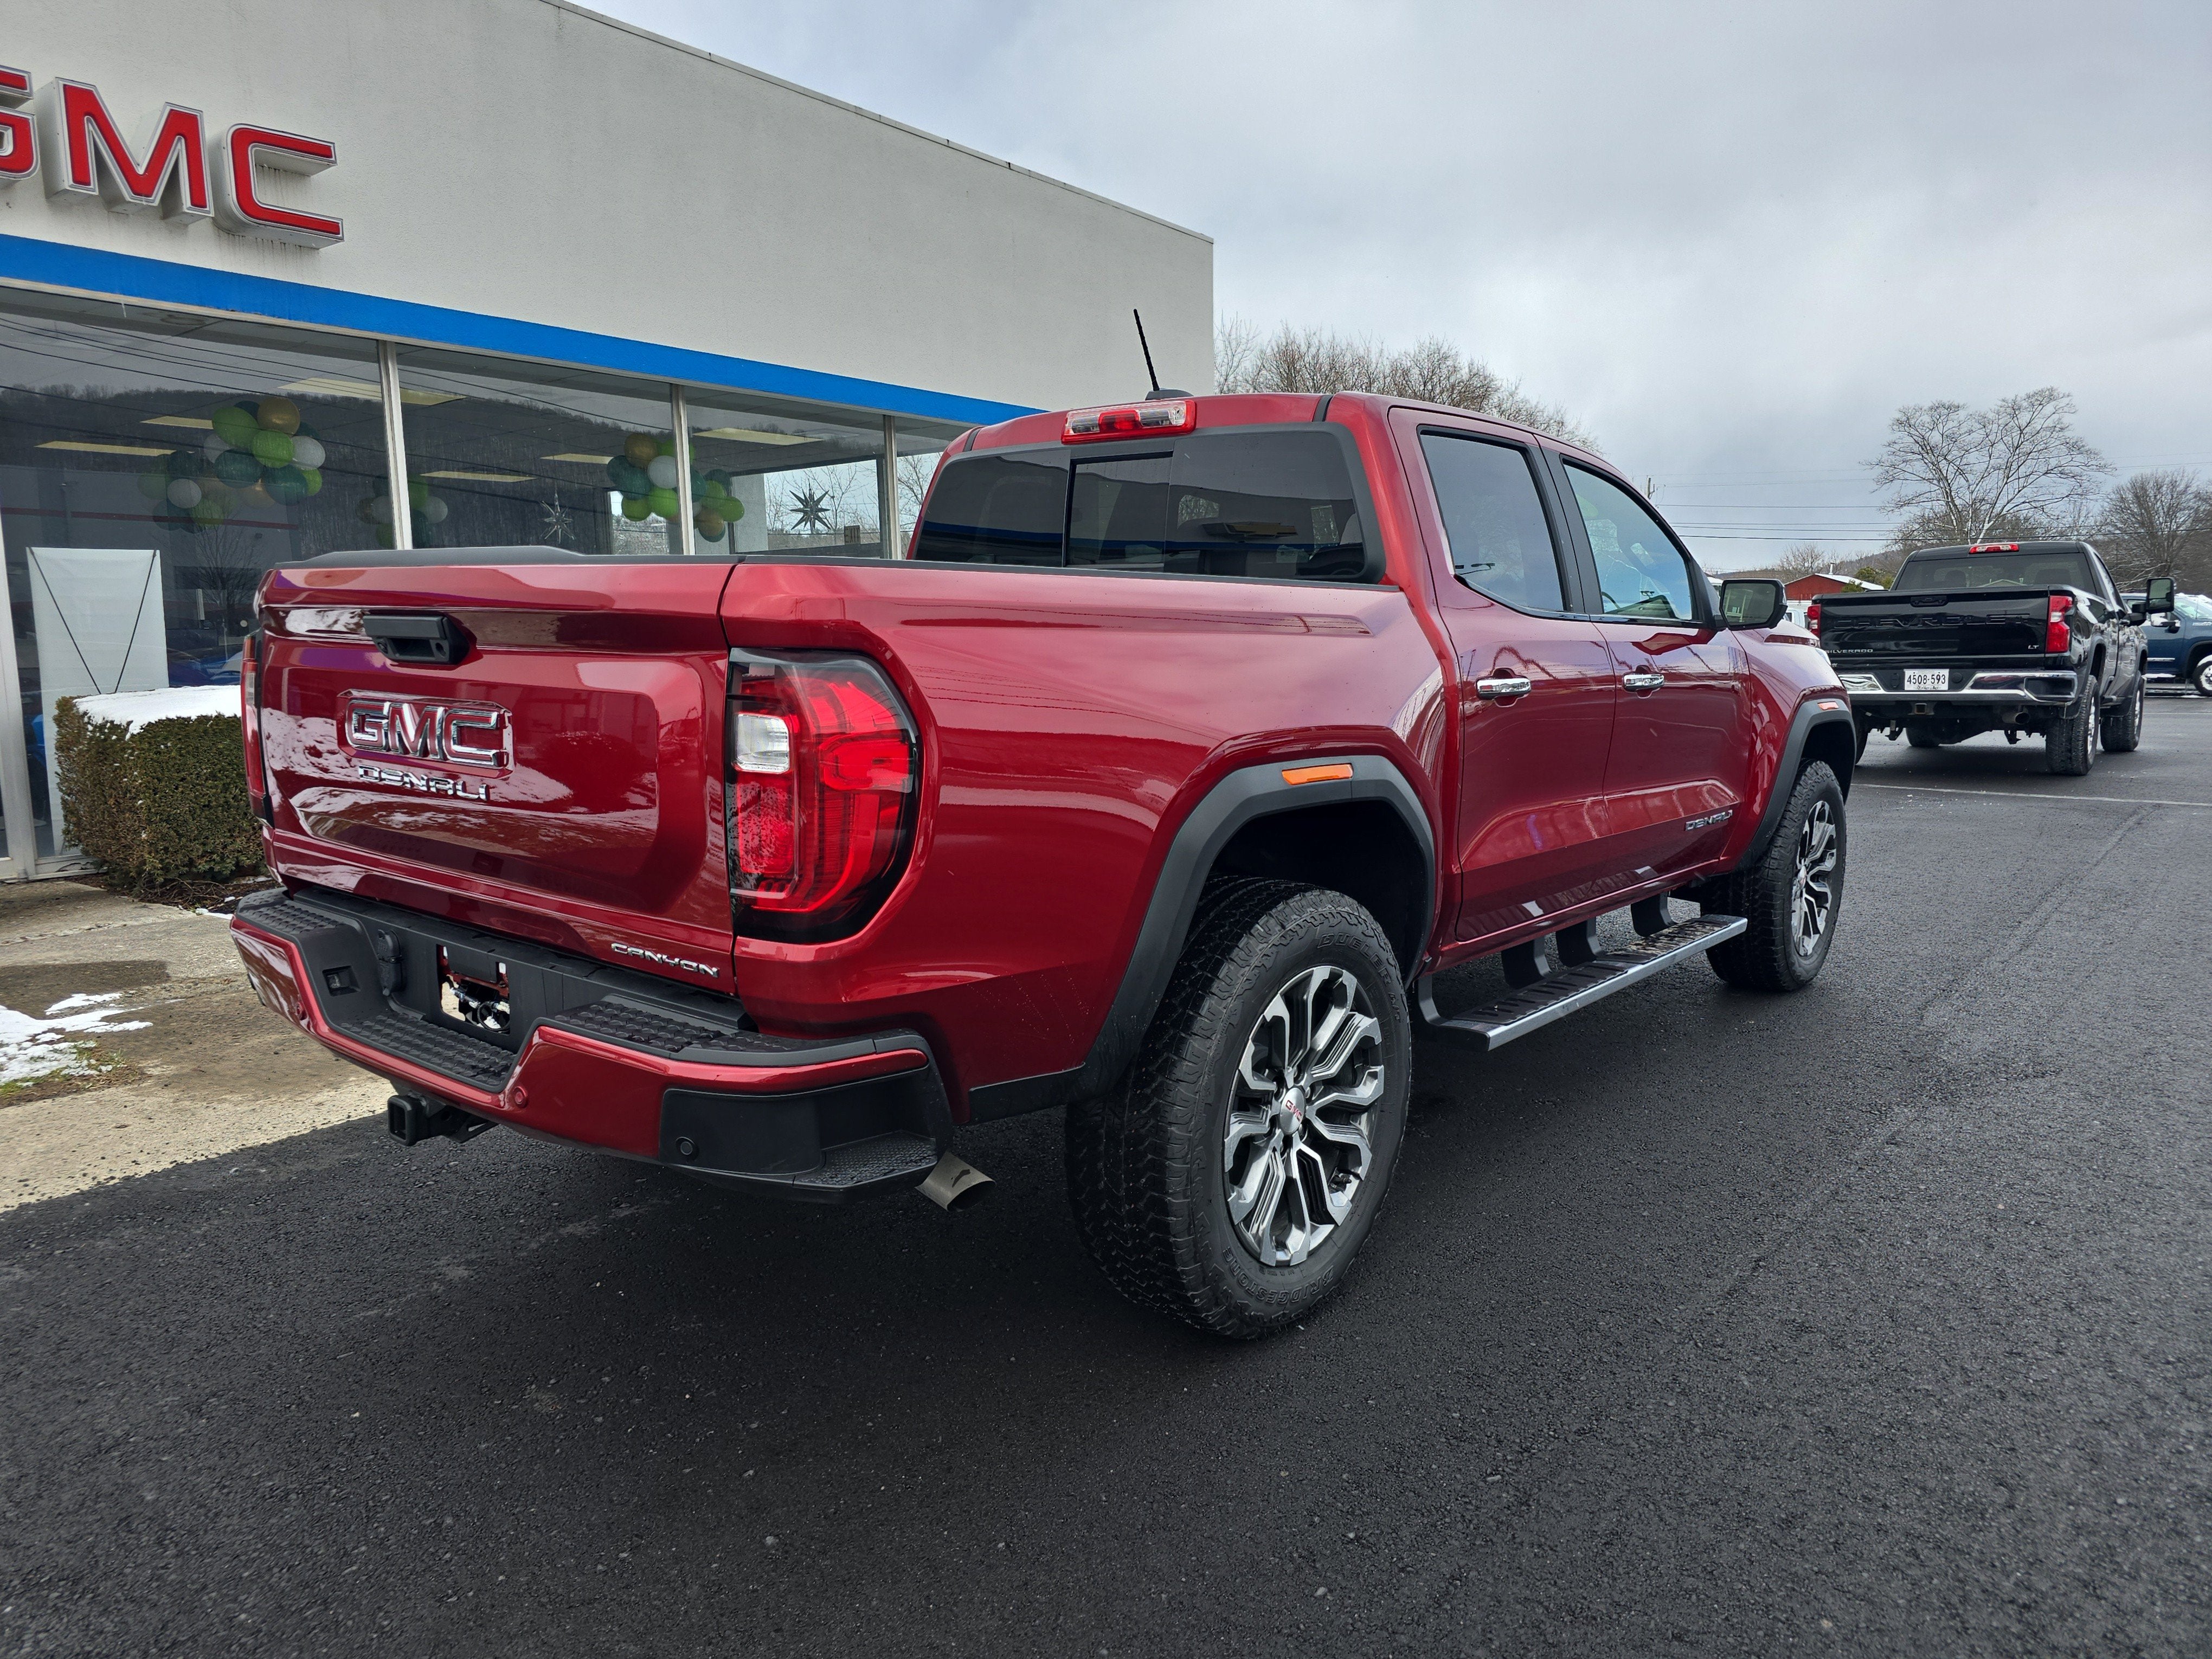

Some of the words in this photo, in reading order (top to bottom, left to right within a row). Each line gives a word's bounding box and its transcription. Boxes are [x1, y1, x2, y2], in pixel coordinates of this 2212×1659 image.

[345, 699, 500, 769] GMC
[358, 764, 490, 801] DENALI
[1685, 809, 1733, 831] DENALI
[611, 943, 720, 978] CANYON
[1317, 933, 1391, 986] DUELER
[1285, 1099, 1302, 1122] GMC
[1222, 1246, 1334, 1304] BRIDGESTONE
